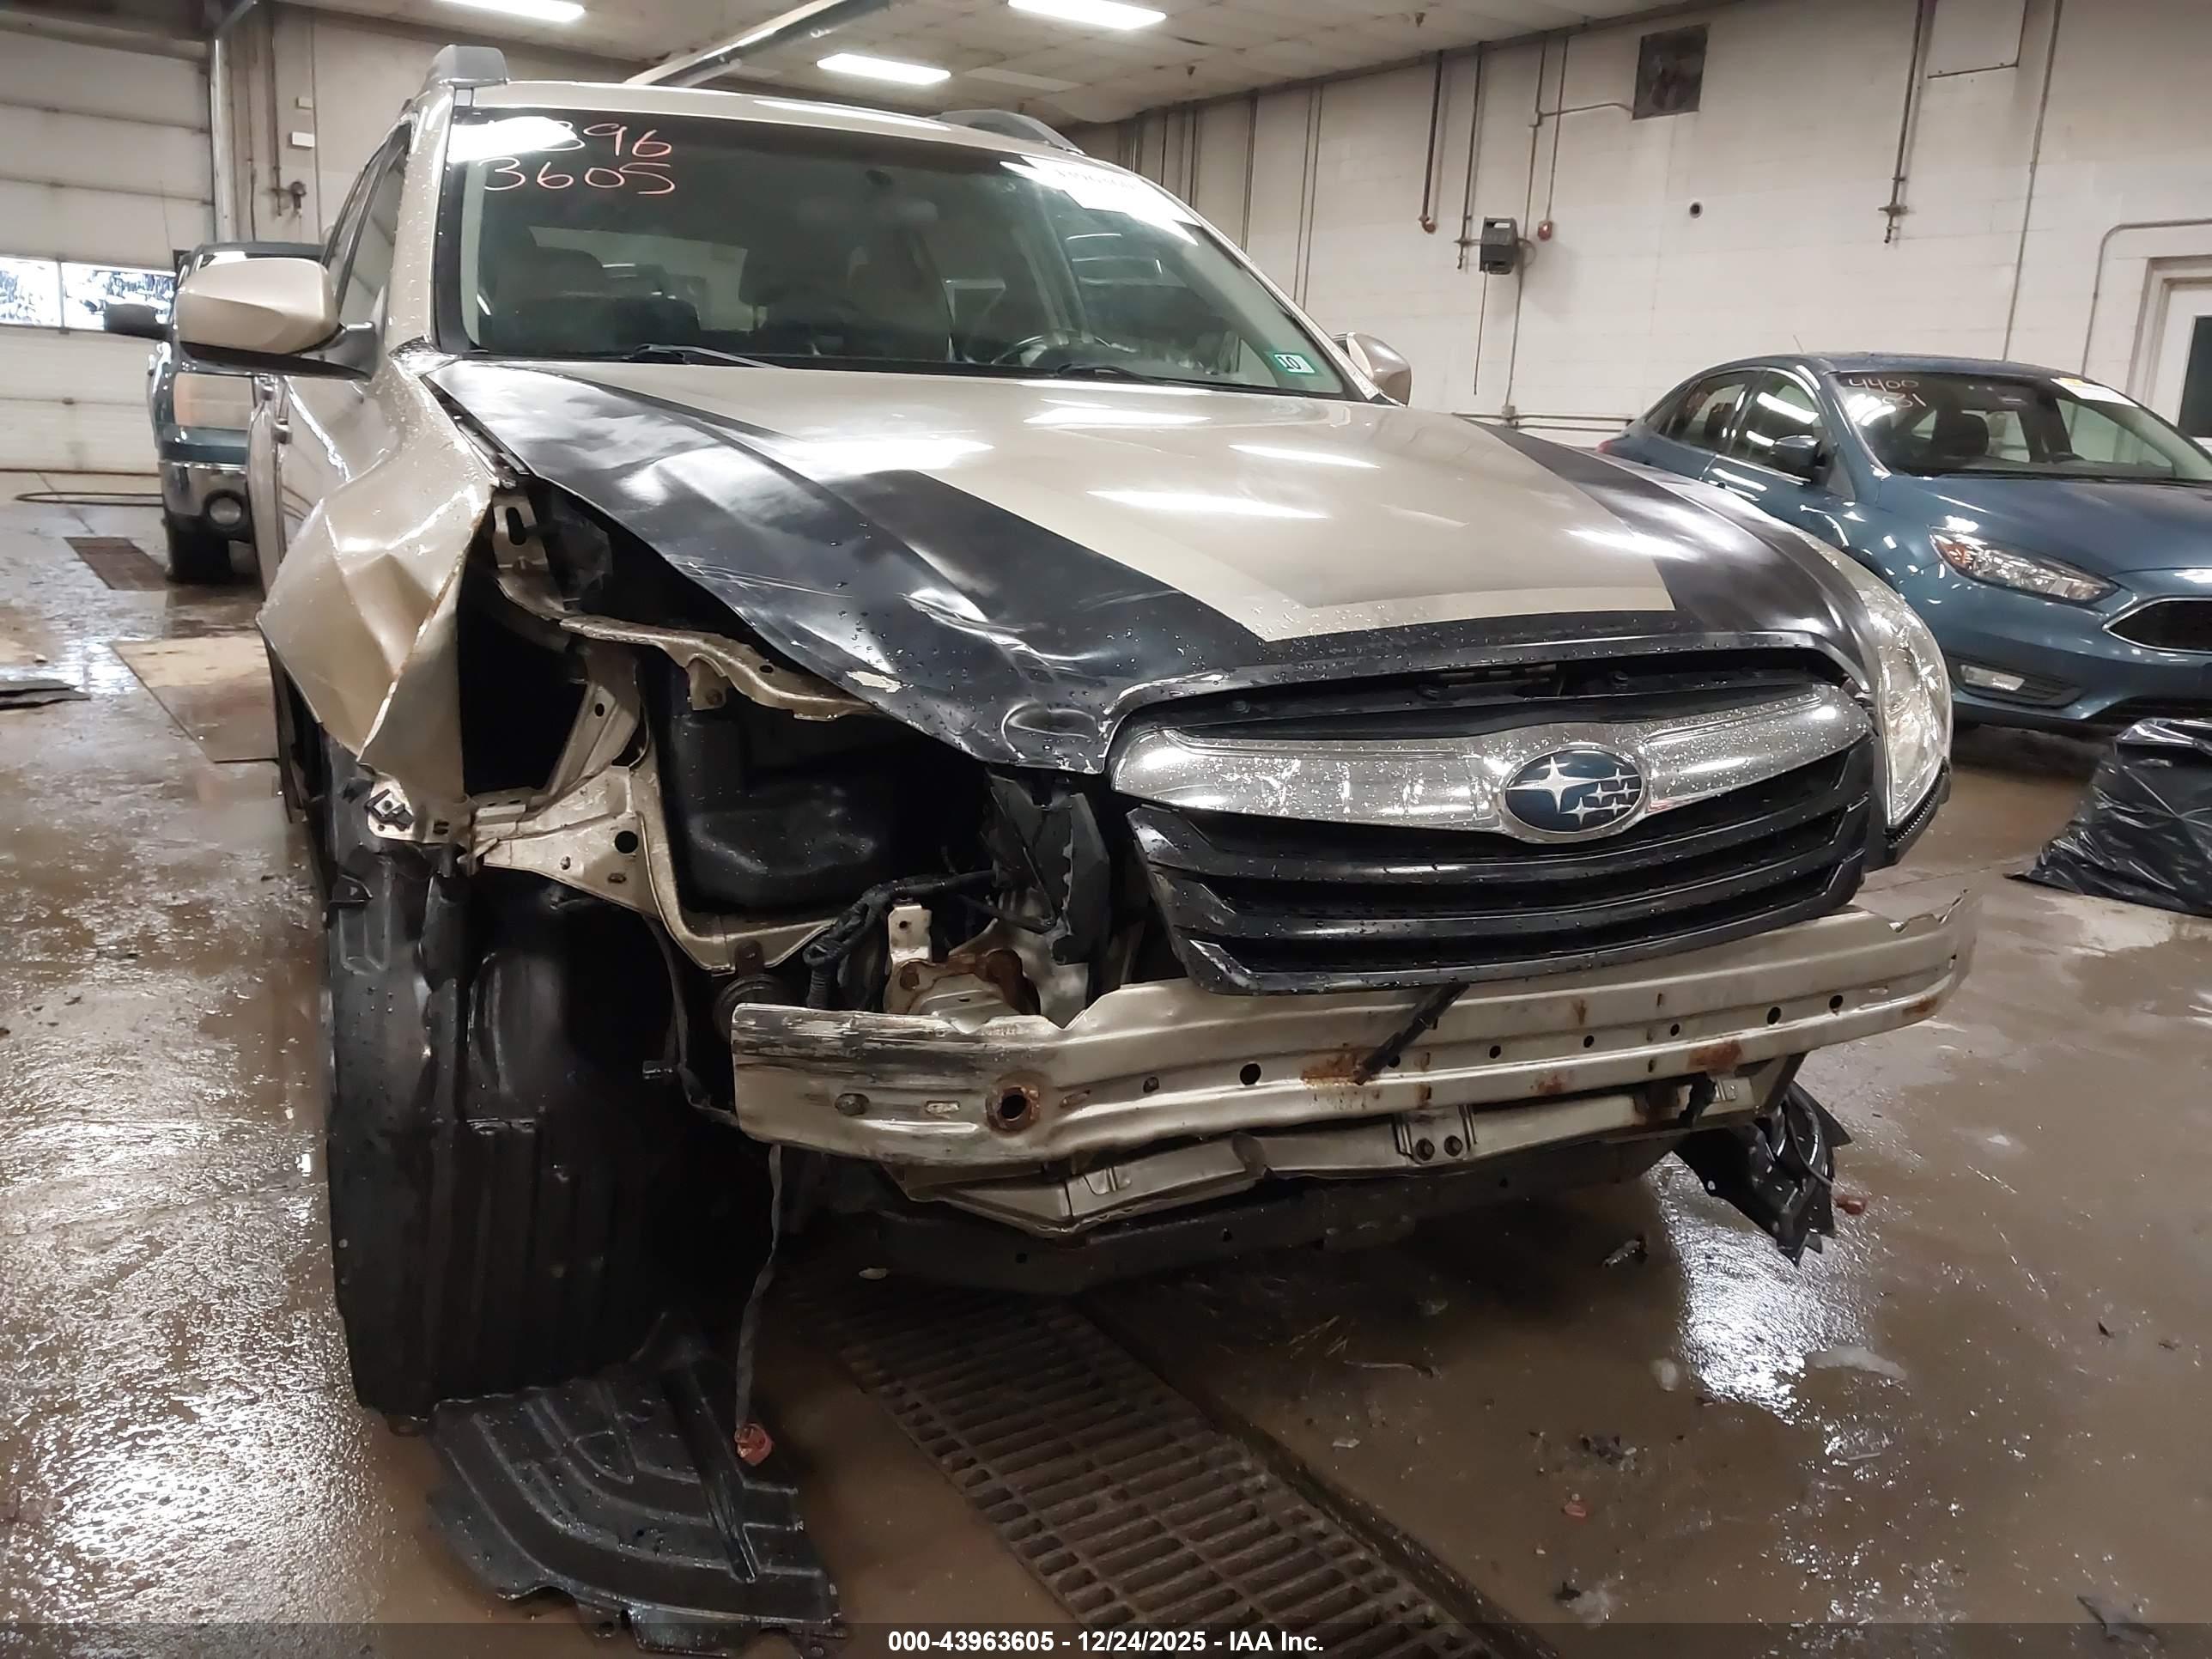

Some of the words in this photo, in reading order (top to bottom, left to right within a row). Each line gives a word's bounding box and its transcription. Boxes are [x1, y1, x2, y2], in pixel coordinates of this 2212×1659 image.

[489, 119, 673, 159] 396
[478, 156, 676, 195] 3605
[1848, 377, 1920, 393] 4400
